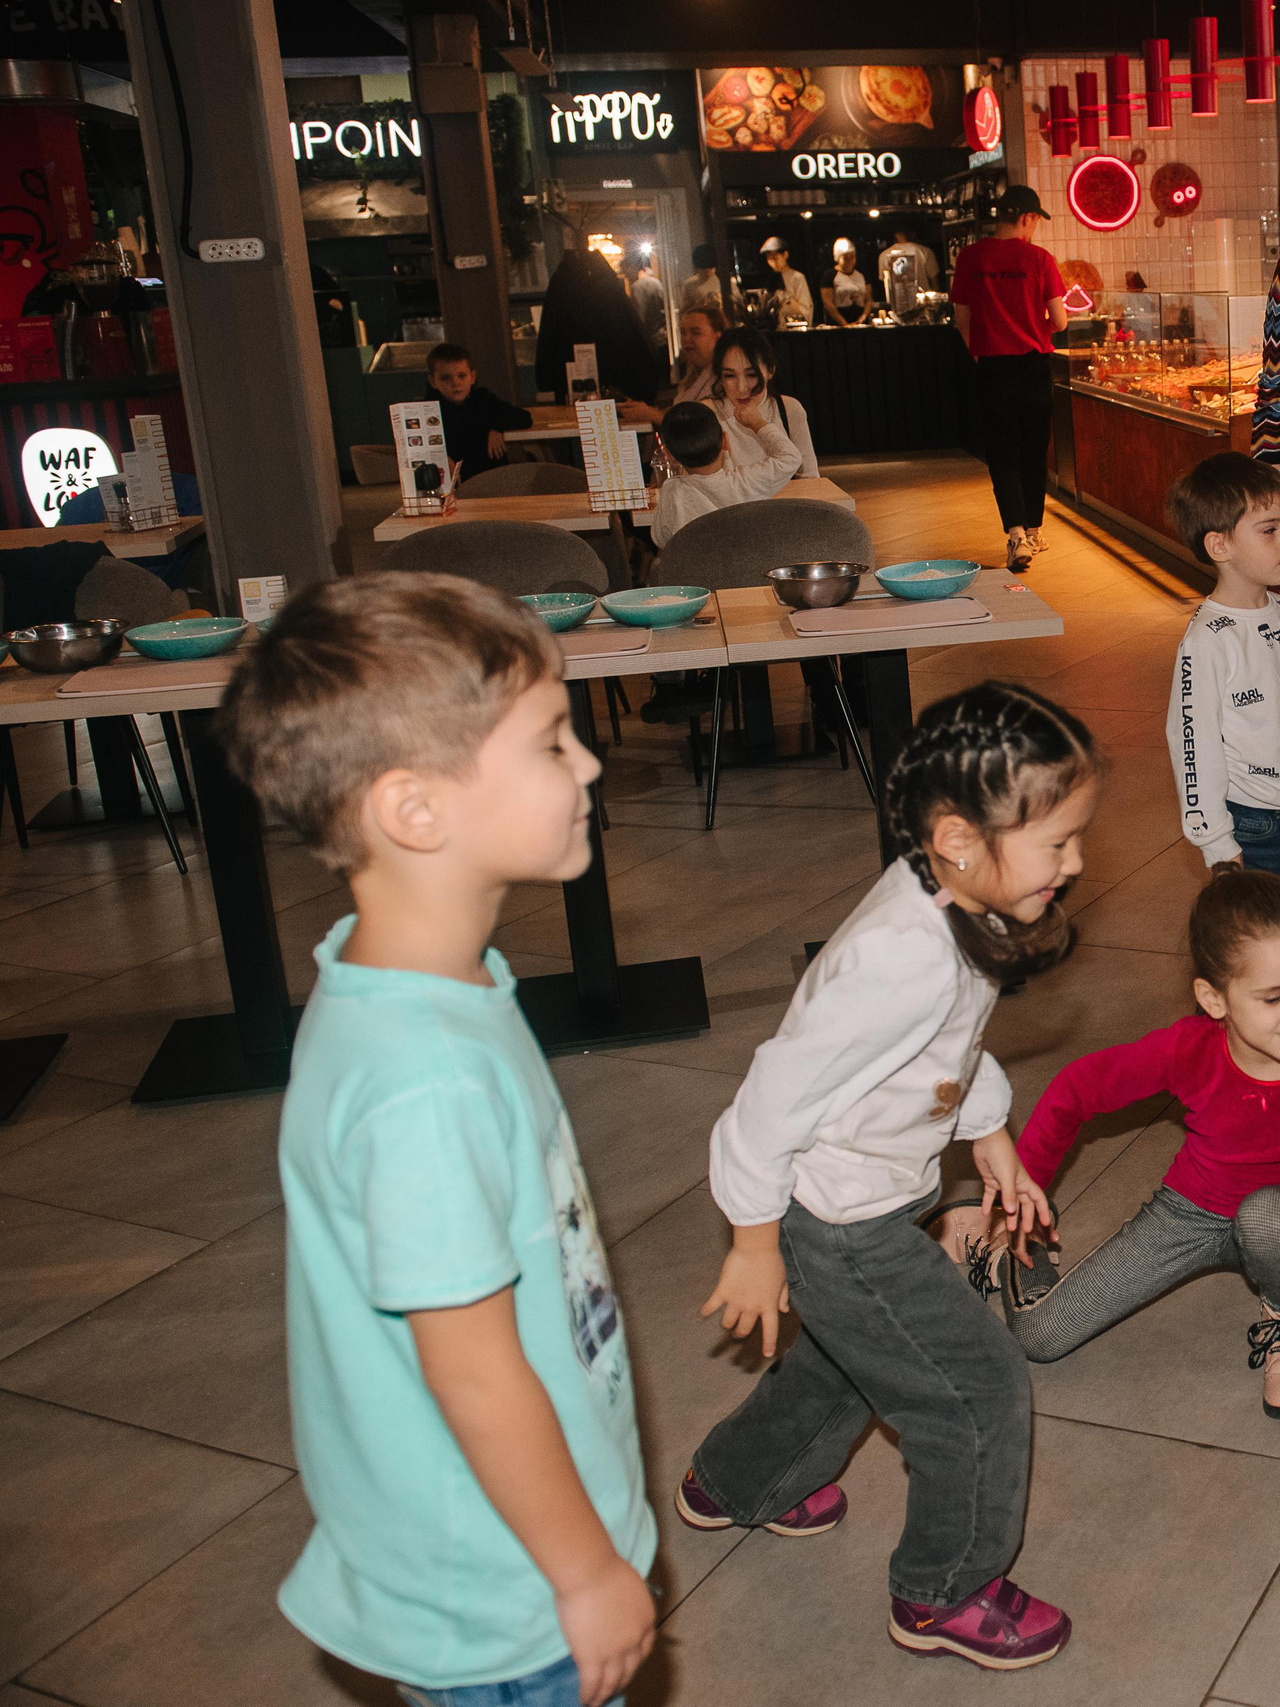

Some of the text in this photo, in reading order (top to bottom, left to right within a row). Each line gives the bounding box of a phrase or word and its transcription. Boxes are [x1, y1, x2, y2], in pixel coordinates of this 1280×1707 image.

[791, 151, 901, 180] ORERO
[39, 447, 97, 471] WAF
[66, 473, 79, 487] &
[1206, 615, 1234, 630] KARL
[1231, 687, 1264, 702] KARL
[1234, 696, 1265, 708] LAGERFELD
[1181, 655, 1199, 807] KARL LAGERFELD
